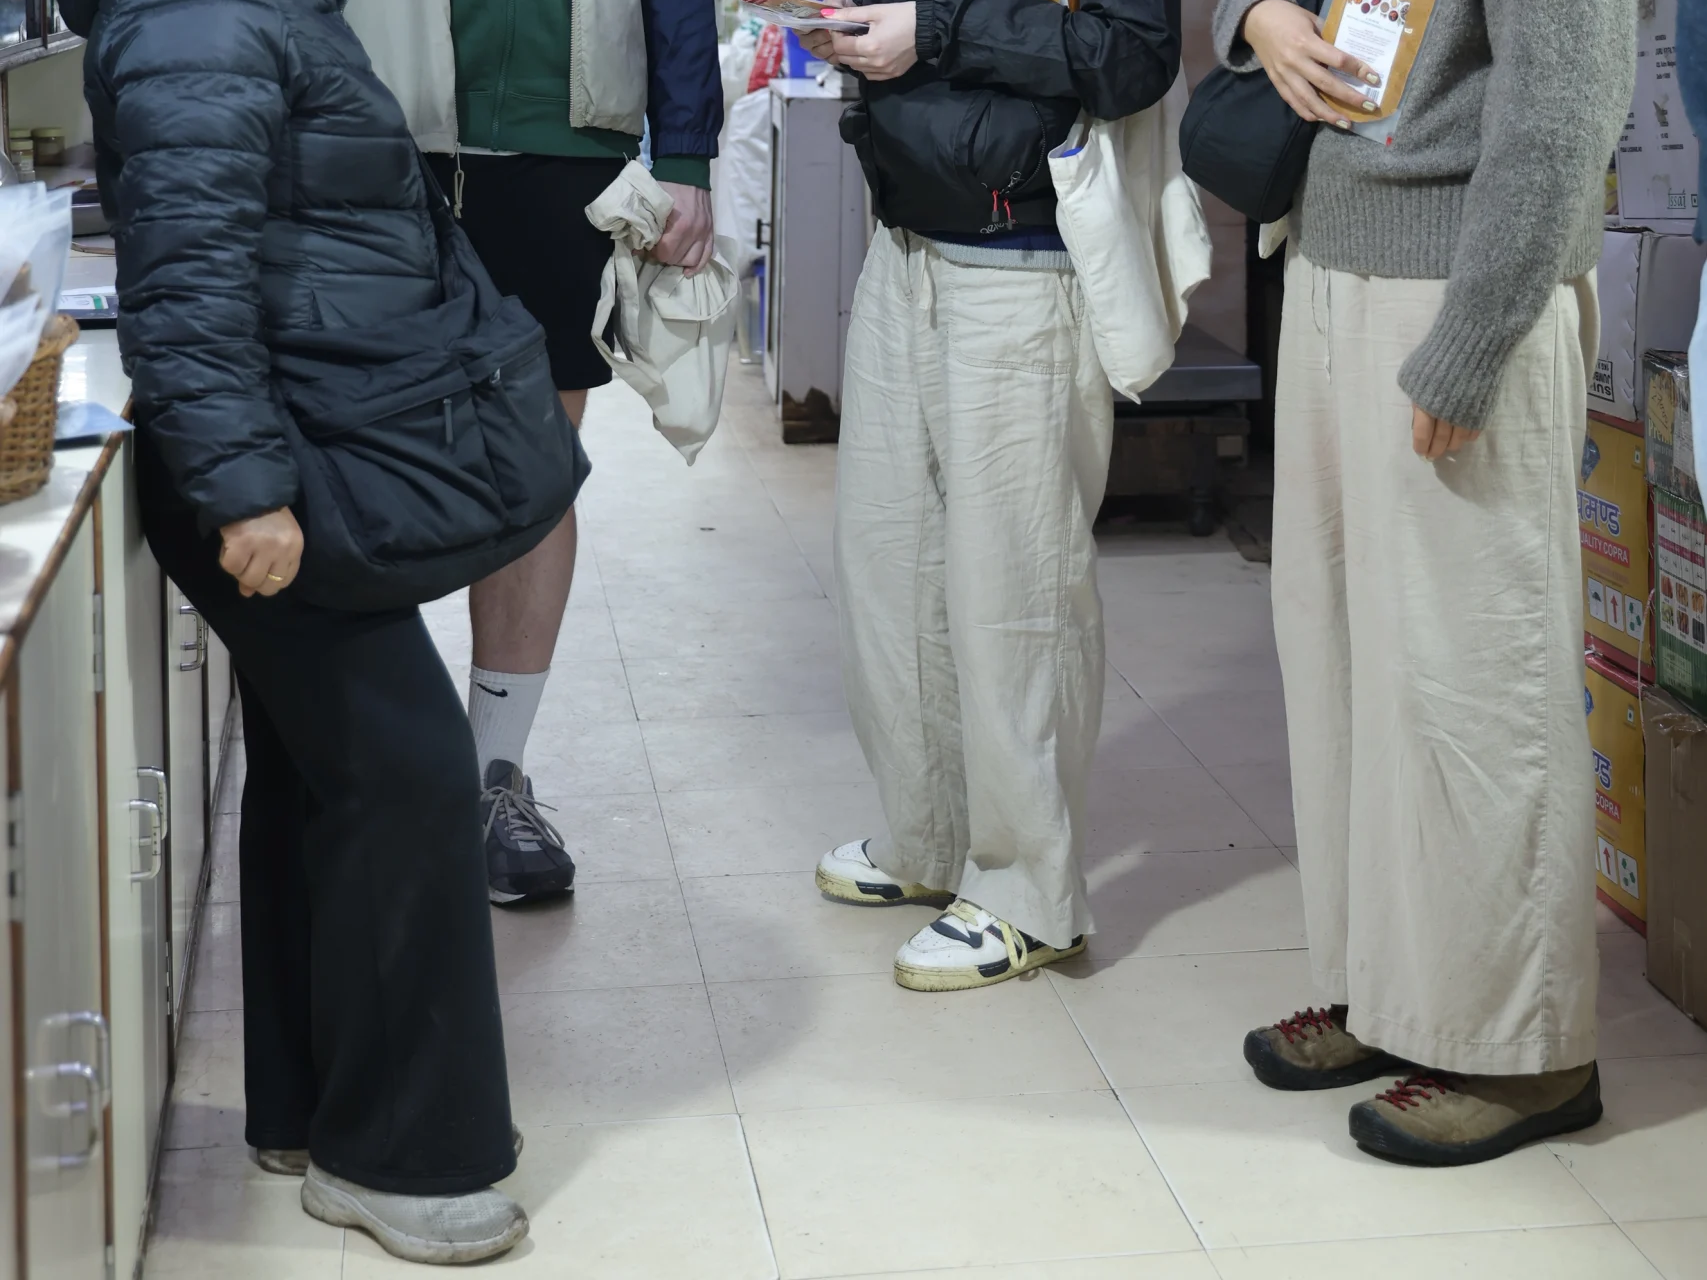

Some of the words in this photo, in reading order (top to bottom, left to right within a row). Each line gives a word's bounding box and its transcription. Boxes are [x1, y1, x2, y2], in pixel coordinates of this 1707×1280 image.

[1580, 531, 1603, 552] UALITY
[1603, 541, 1629, 564] COPRA
[1595, 792, 1620, 820] COPRA
